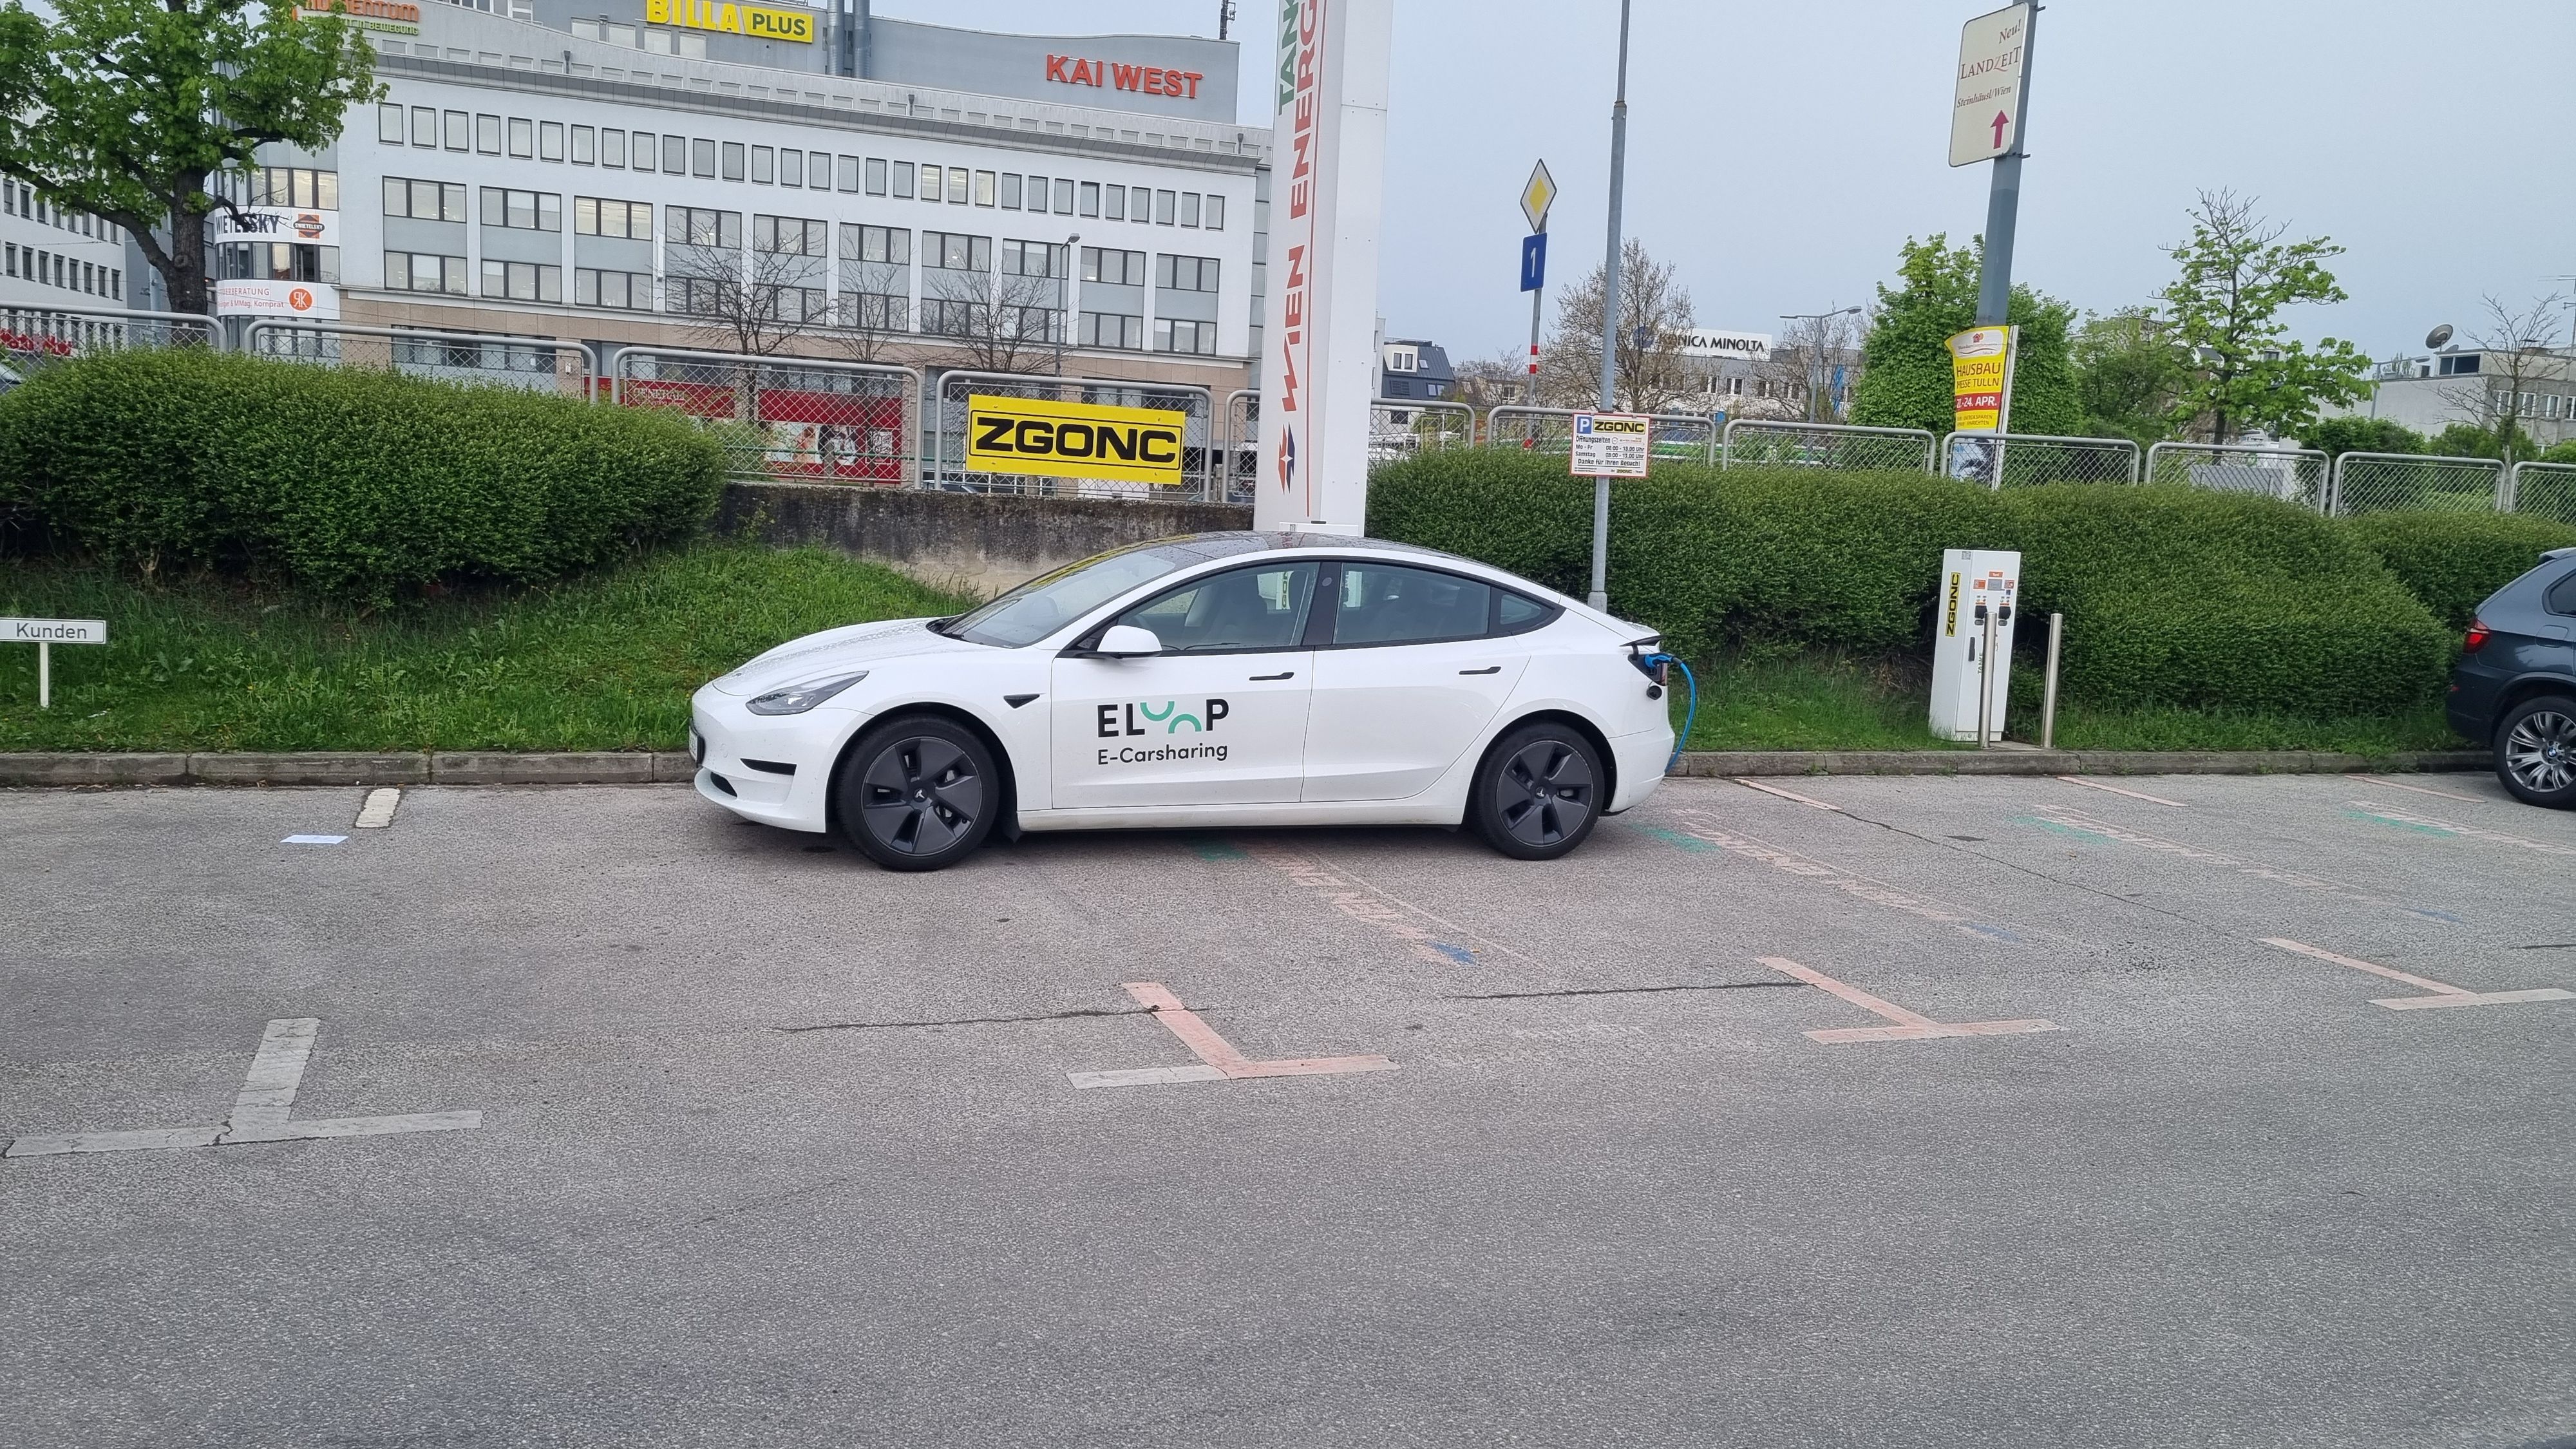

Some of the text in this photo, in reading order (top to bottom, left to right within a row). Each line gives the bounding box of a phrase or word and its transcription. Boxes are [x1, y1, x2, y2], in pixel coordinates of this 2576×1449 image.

[647, 0, 806, 36] BILLA PLUS
[1999, 19, 2021, 44] Neu!
[1278, 0, 1299, 116] TAN
[1960, 46, 2022, 80] LANDZEIT
[1046, 54, 1203, 99] KAI WEST
[1530, 247, 1537, 278] 1
[1710, 337, 1765, 353] MINOLTA
[1956, 363, 2001, 377] HAUSBAU
[1973, 377, 1999, 387] TULLN
[1975, 396, 1997, 406] APR.
[1580, 419, 1644, 432] P ZGONC
[976, 417, 1177, 463] ZGONC
[1576, 435, 1611, 444] Öffnungszeiten
[1947, 574, 1960, 636] ZGONC
[17, 622, 87, 639] Kunden
[1098, 743, 1228, 765] E-Carsharing
